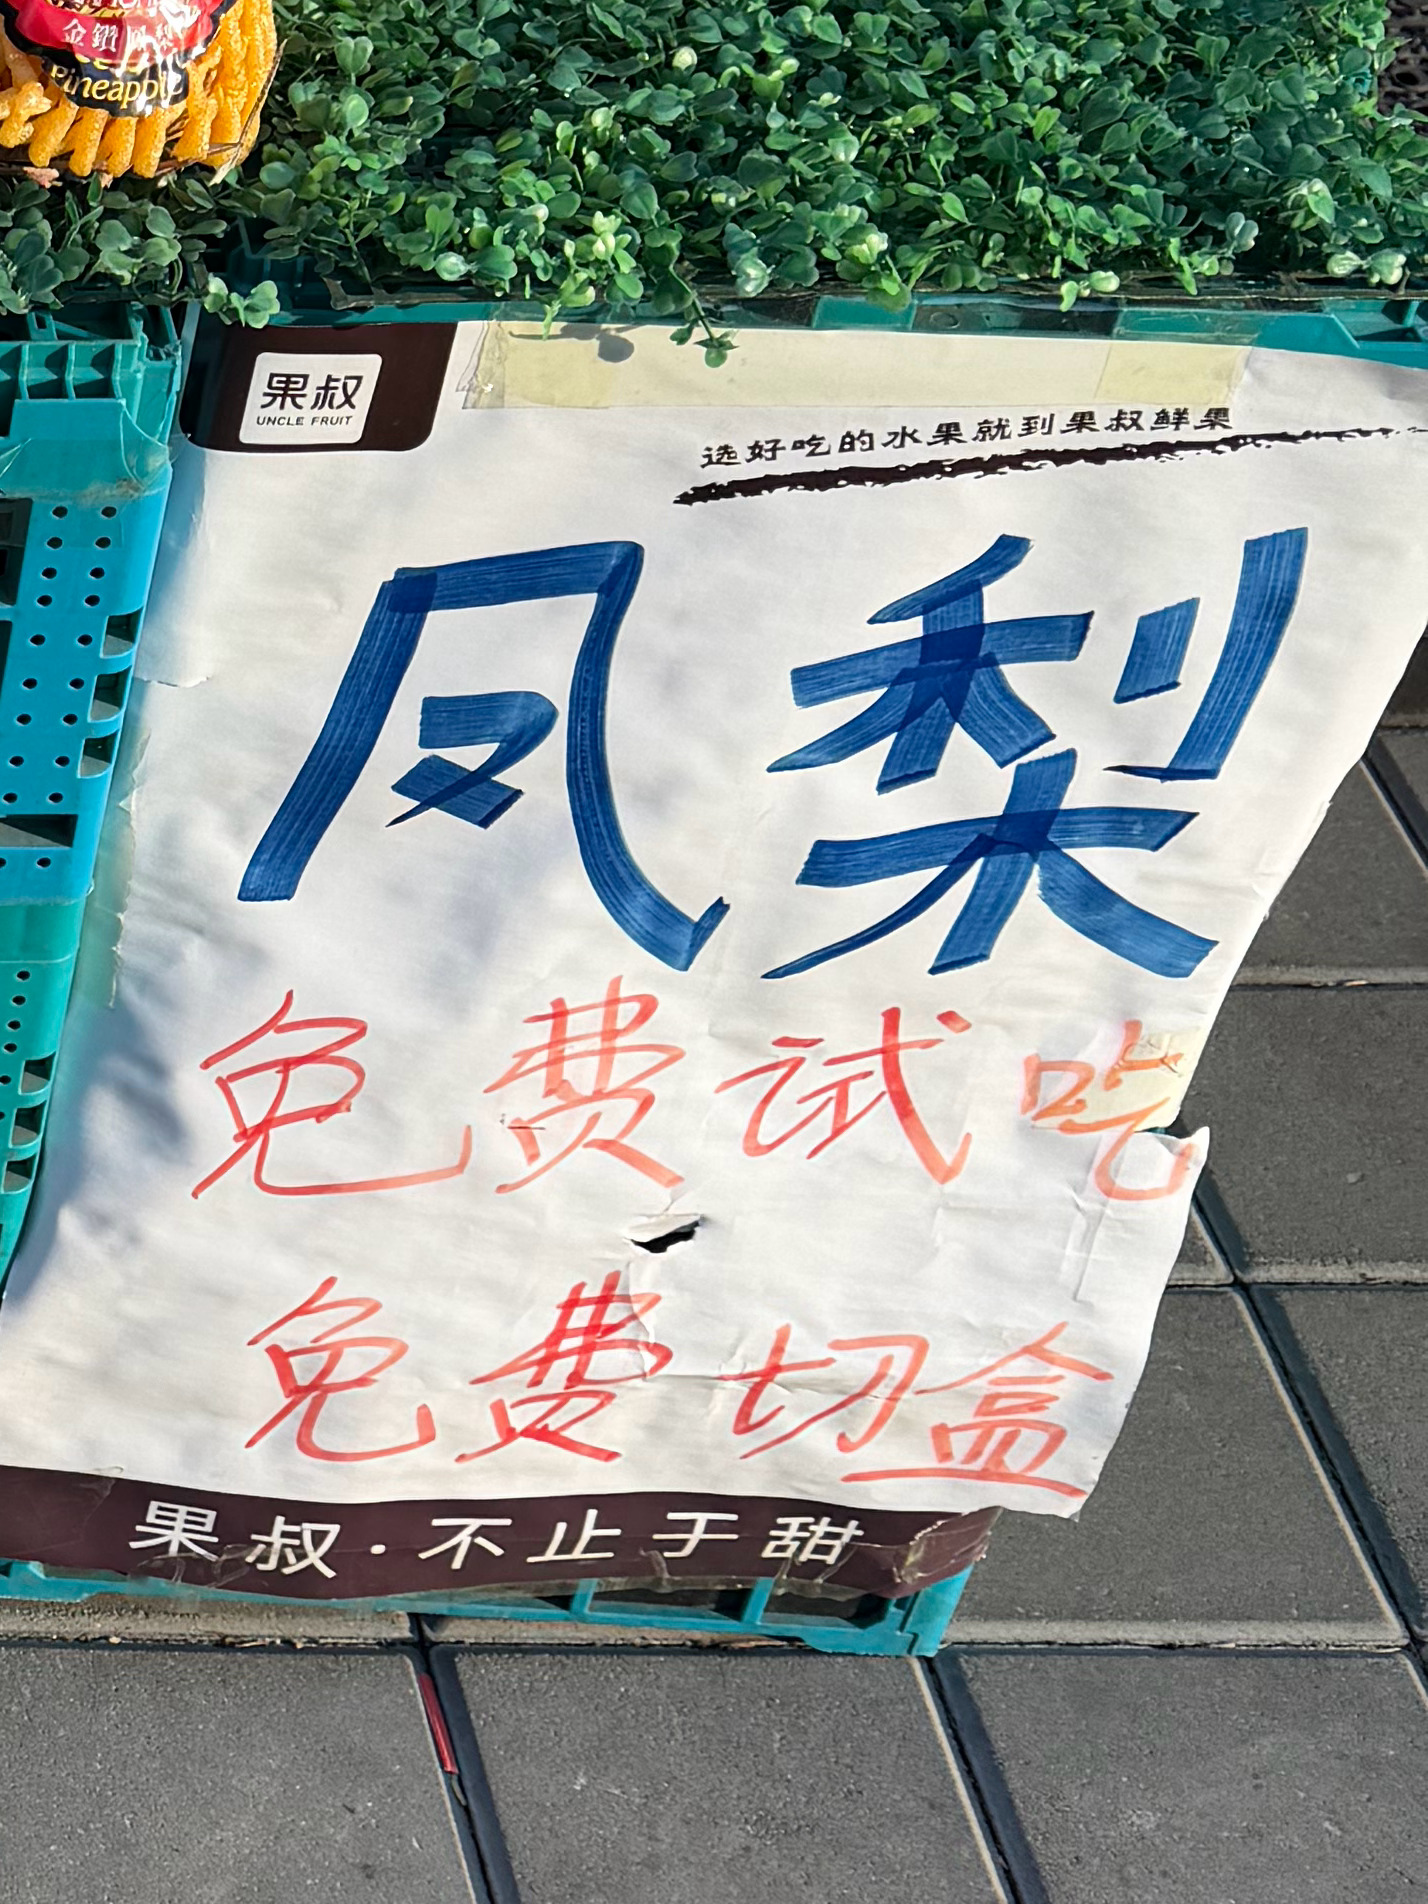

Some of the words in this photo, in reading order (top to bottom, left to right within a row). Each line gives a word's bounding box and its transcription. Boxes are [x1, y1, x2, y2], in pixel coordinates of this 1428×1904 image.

[256, 415, 304, 427] UNCLE
[311, 415, 353, 427] FRUIT
[260, 372, 364, 411] 果叔
[701, 407, 1233, 469] 选好吃的水果就到果叔鲜果
[237, 528, 1307, 978] 凤梨
[191, 974, 1194, 1202] 免费试吃
[242, 1270, 1114, 1498] 免费切盒
